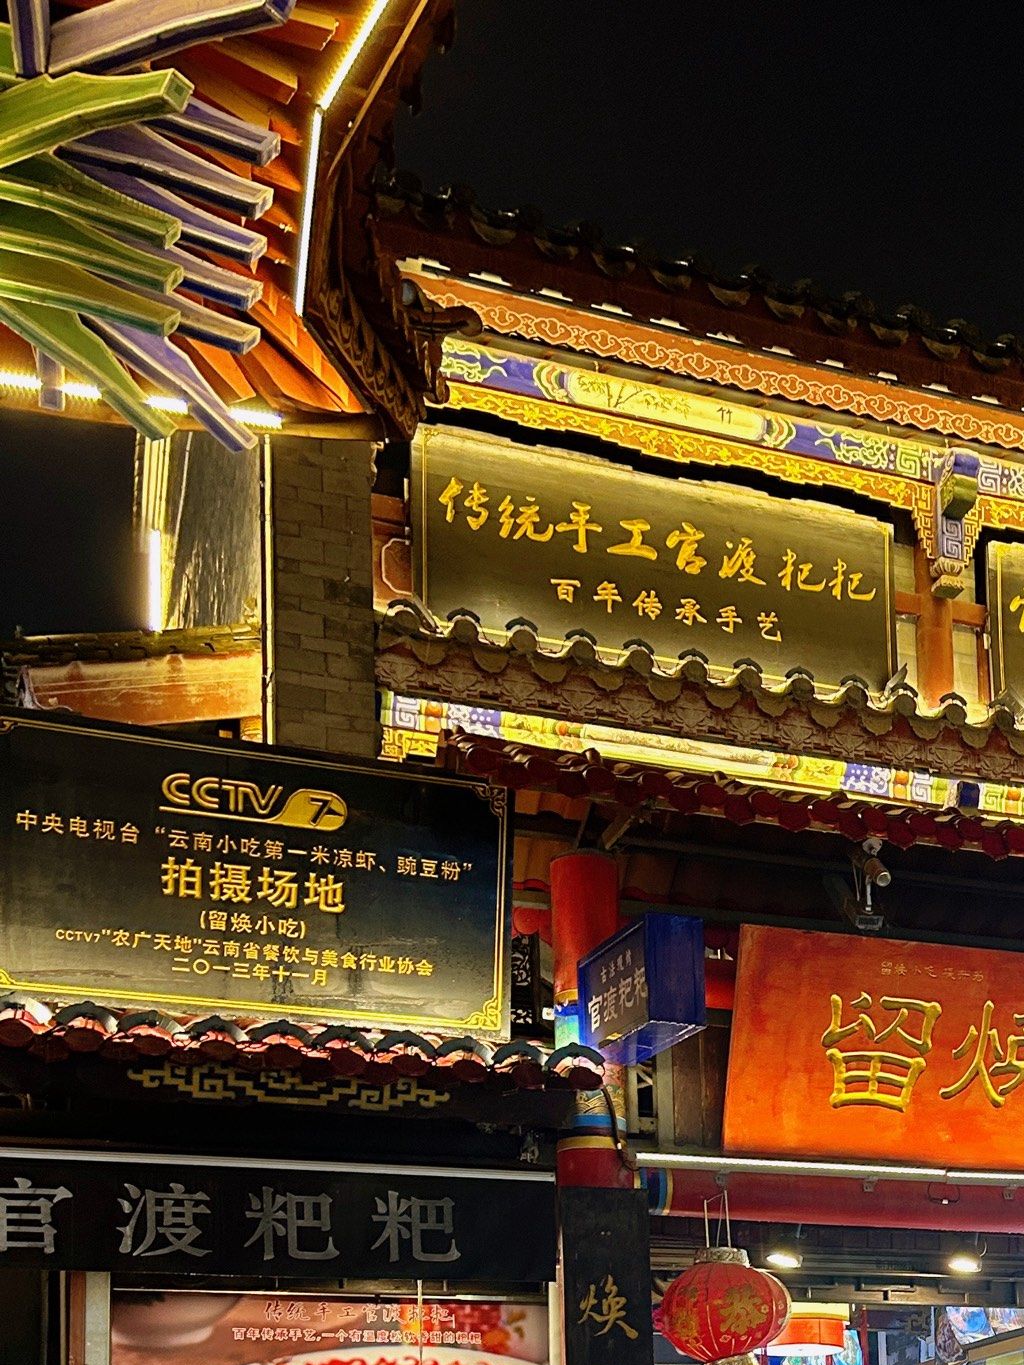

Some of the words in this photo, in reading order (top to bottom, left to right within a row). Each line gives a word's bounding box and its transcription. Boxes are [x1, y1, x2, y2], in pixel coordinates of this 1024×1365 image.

[550, 578, 782, 642] 百年传承手艺
[161, 772, 283, 815] CCTV
[15, 809, 141, 844] 中央电视台
[160, 856, 347, 914] 拍摄场地
[587, 967, 648, 1033] 官渡粑粑
[0, 1177, 462, 1263] 官渡粑粑
